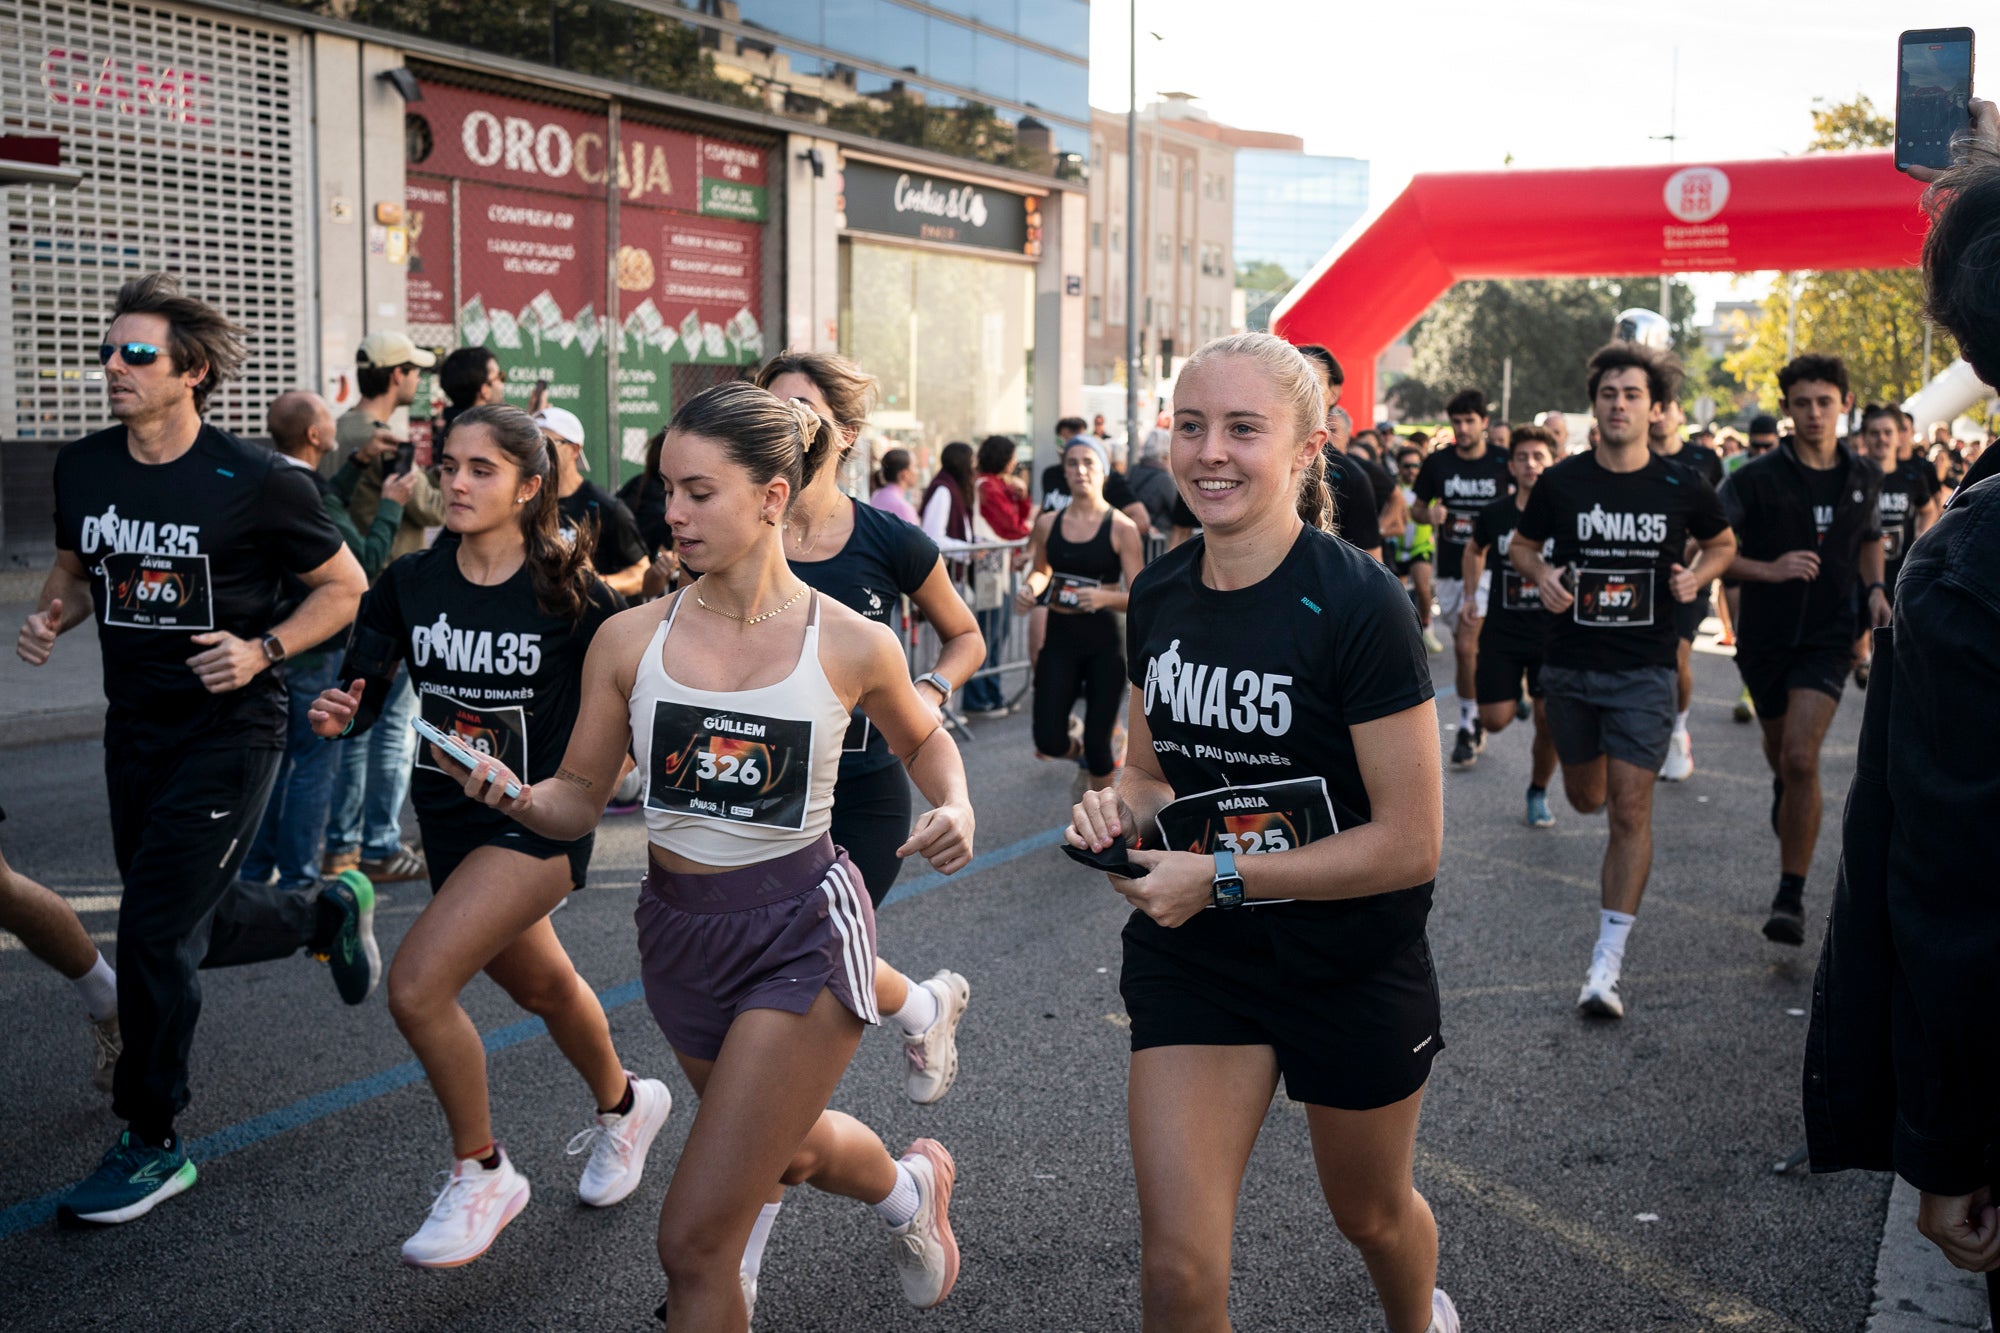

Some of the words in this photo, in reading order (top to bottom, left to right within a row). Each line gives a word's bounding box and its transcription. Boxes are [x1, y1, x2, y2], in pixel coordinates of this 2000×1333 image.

[140, 559, 172, 570] JAVIER
[136, 580, 178, 603] 676
[459, 687, 481, 699] PAU
[484, 687, 534, 700] DINARÈS
[703, 716, 766, 738] GUILLEM
[1194, 744, 1223, 760] PAU
[1224, 750, 1292, 767] DINARÈS
[696, 751, 761, 786] 326
[1217, 795, 1269, 813] MARIA
[1217, 828, 1290, 855] 325
